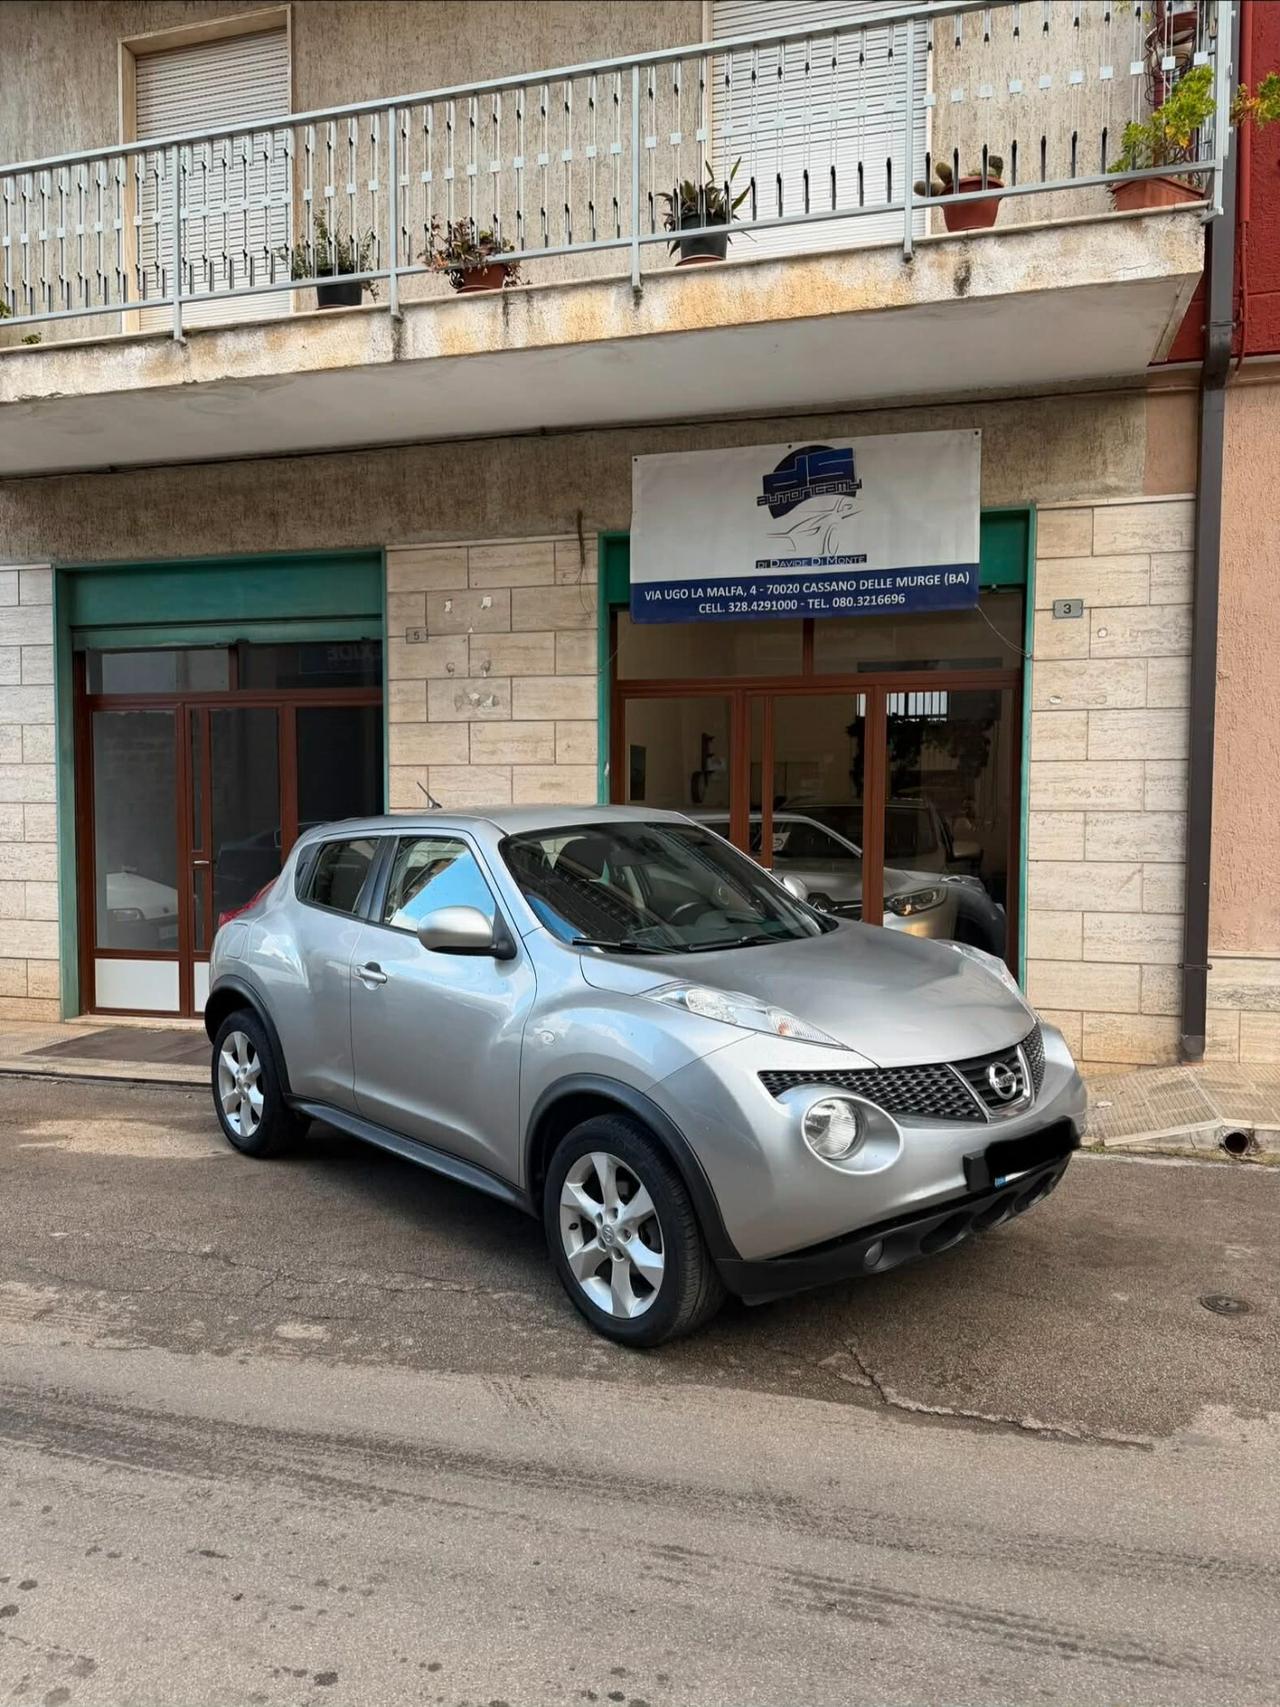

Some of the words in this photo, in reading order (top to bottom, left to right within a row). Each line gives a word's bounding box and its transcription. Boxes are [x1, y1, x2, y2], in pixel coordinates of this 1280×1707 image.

[644, 590, 662, 601] VIA
[664, 588, 689, 600] UGO
[691, 587, 704, 598] LA
[706, 585, 747, 598] MALFA,
[750, 586, 757, 596] 4
[766, 583, 800, 595] 70020
[802, 580, 857, 593] CASSANO
[859, 577, 893, 589] DELLE
[896, 574, 941, 588] MURGE
[944, 571, 970, 586] (BA)
[698, 602, 725, 614] CELL.
[728, 600, 798, 613] 328.4291000
[808, 598, 830, 609] TEL.
[832, 593, 906, 608] 080.3216696
[1063, 603, 1072, 614] 3
